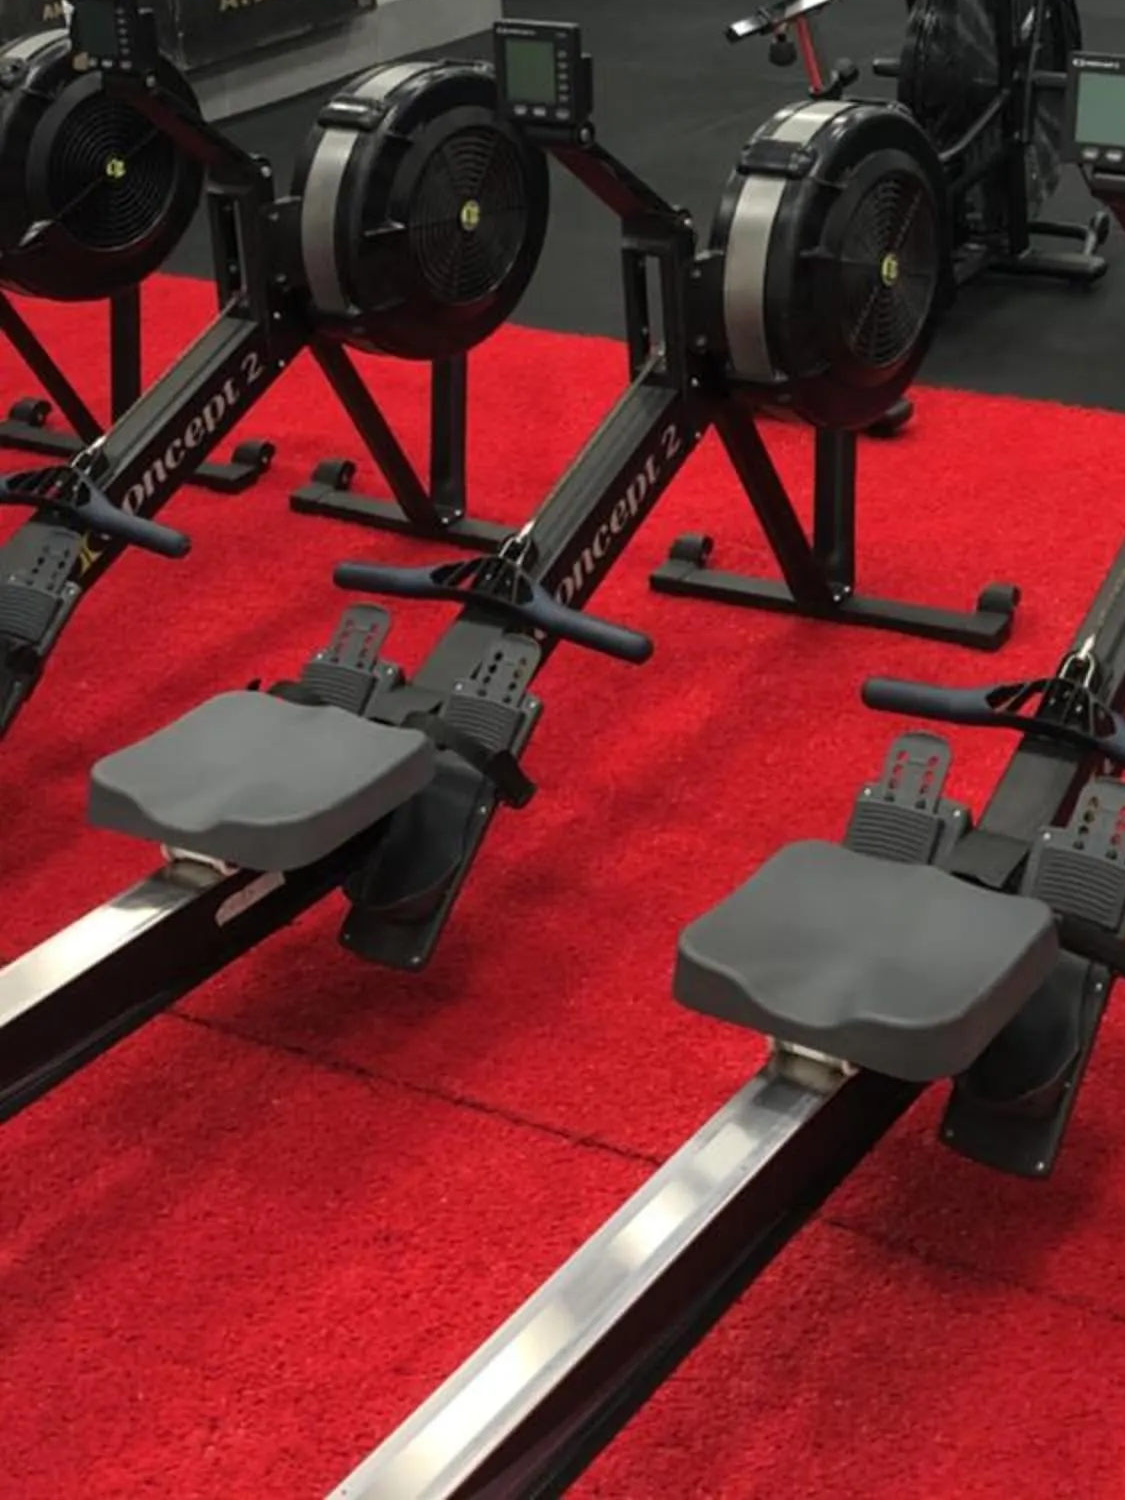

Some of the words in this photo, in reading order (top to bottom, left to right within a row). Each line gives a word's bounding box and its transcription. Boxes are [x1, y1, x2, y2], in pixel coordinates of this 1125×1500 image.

[121, 377, 241, 517] oncept
[241, 352, 266, 383] 2
[556, 455, 661, 606] oncept
[662, 423, 682, 460] 2
